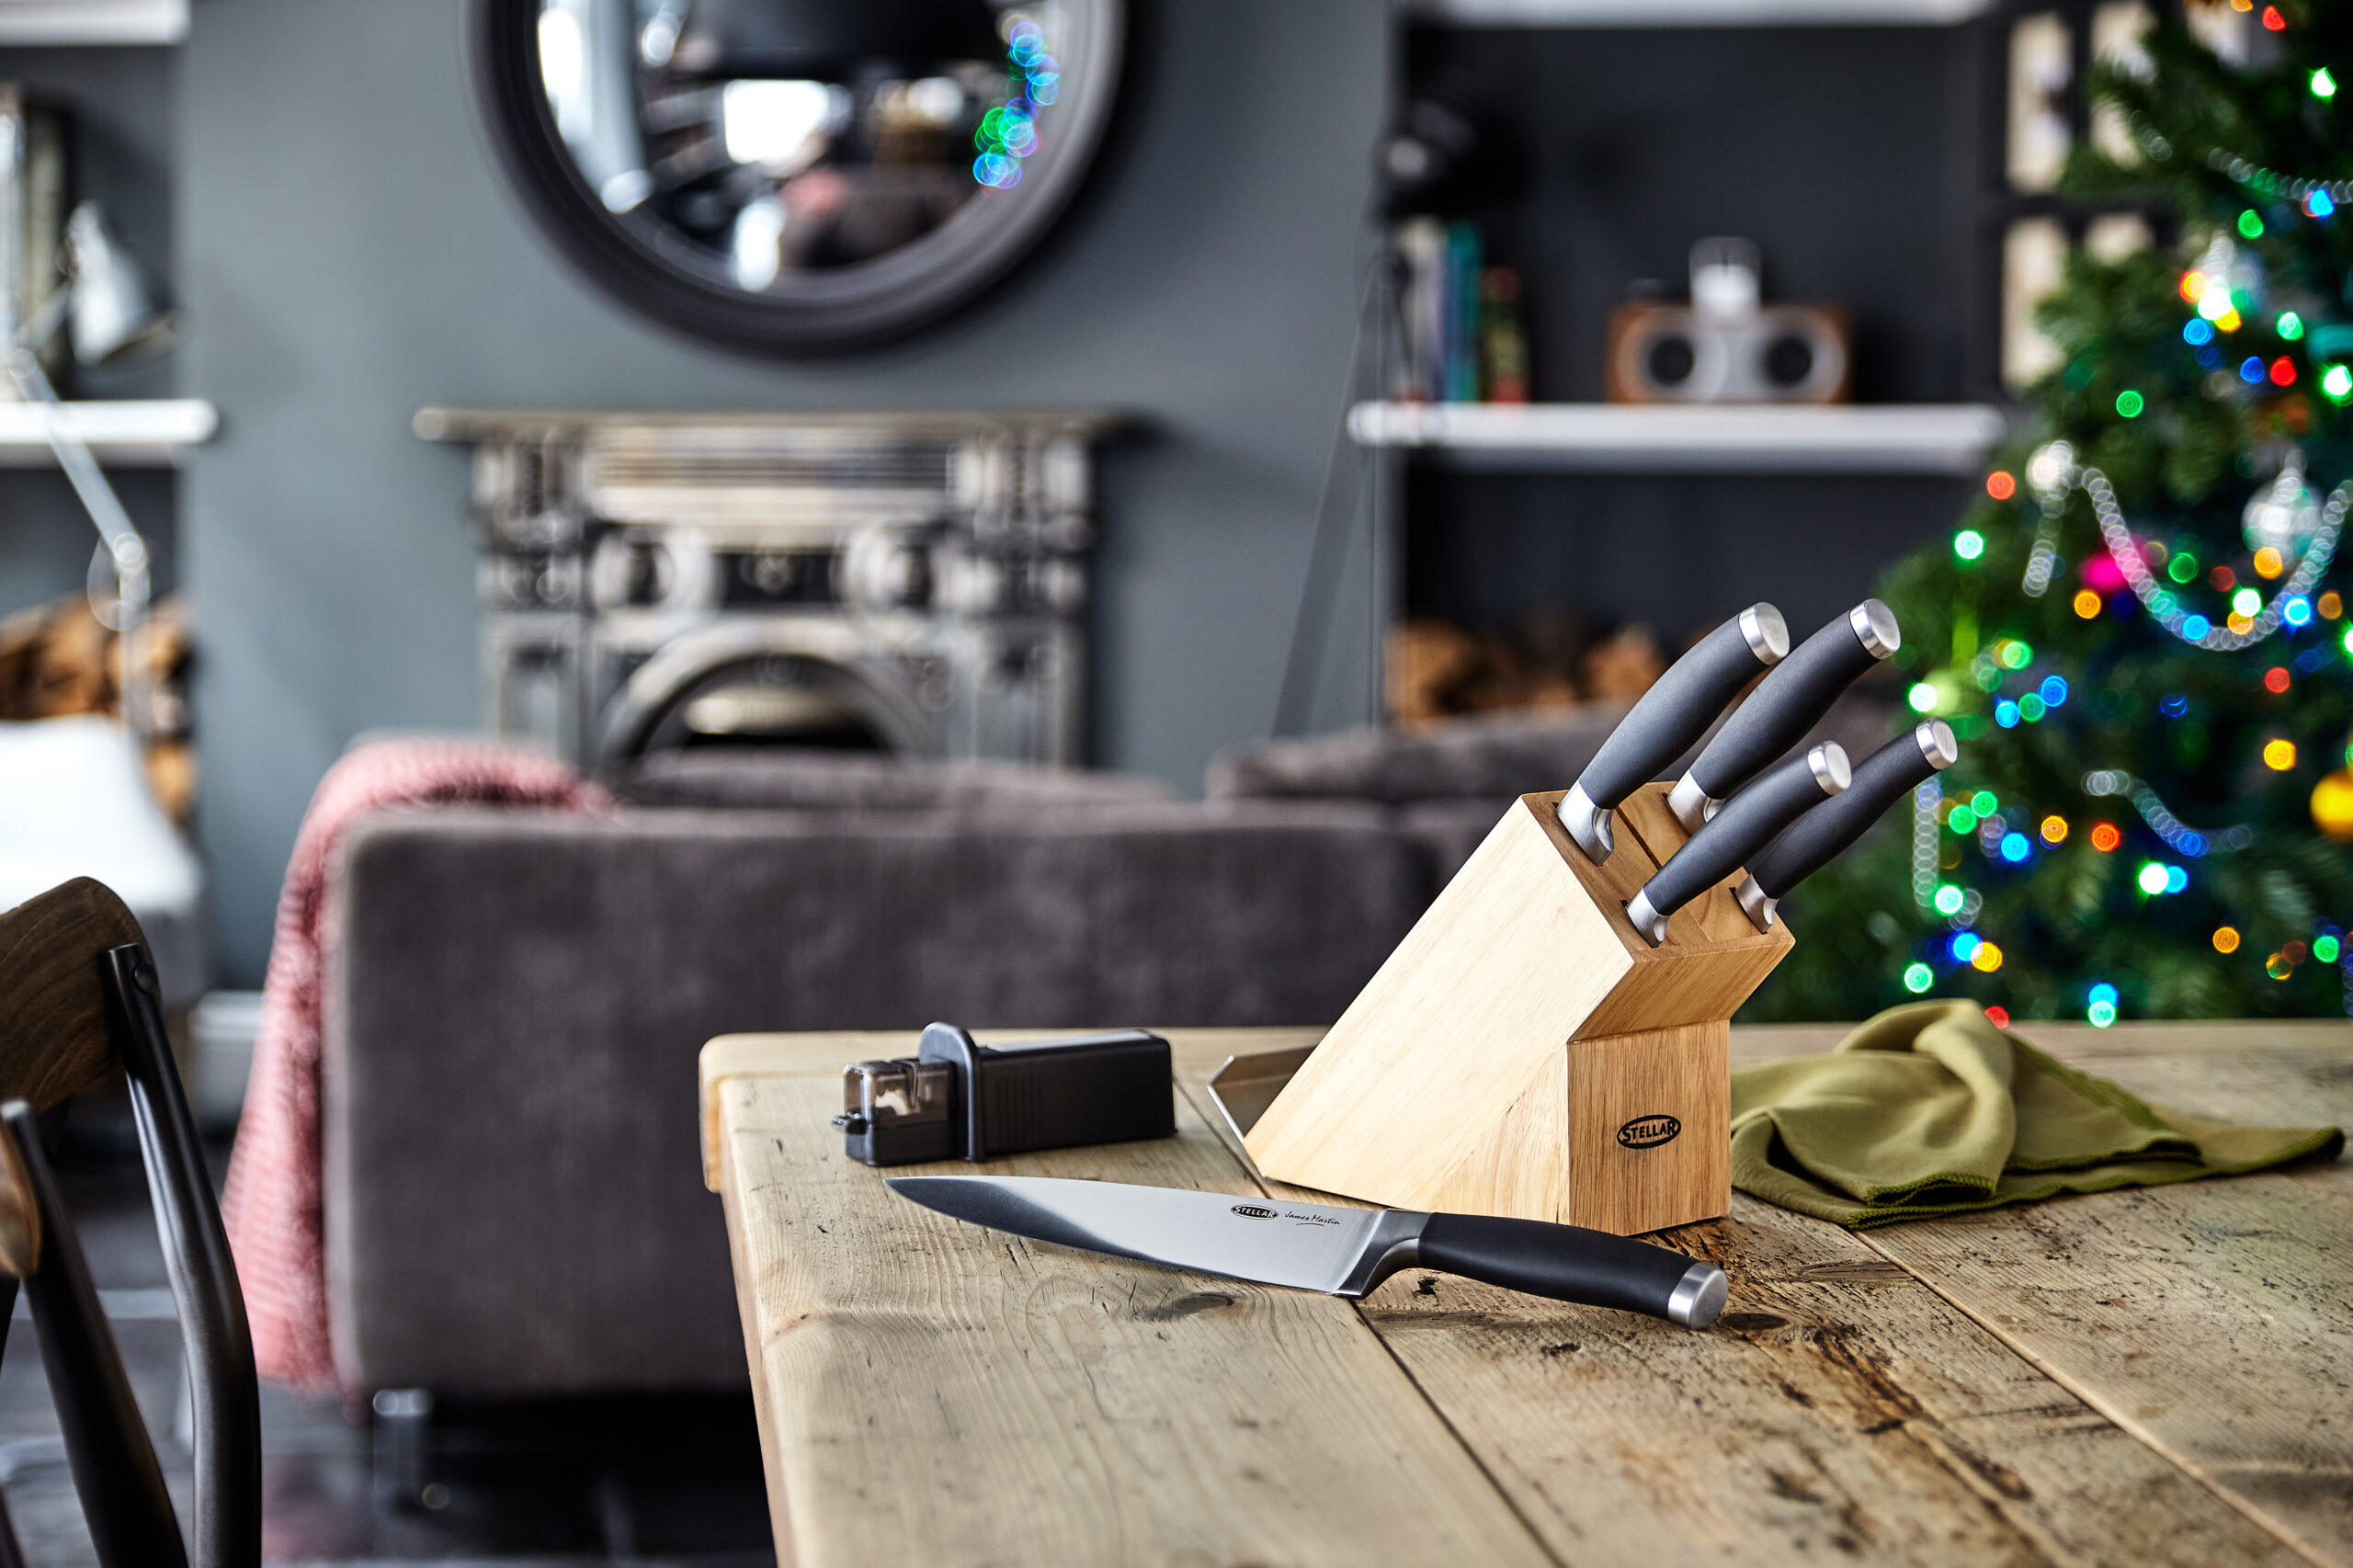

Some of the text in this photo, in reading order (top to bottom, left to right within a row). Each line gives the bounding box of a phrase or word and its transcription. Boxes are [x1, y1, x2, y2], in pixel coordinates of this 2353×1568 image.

[1622, 1119, 1677, 1142] STELLAR
[1233, 1206, 1275, 1219] STELLAR
[1285, 1210, 1341, 1225] James Martin
